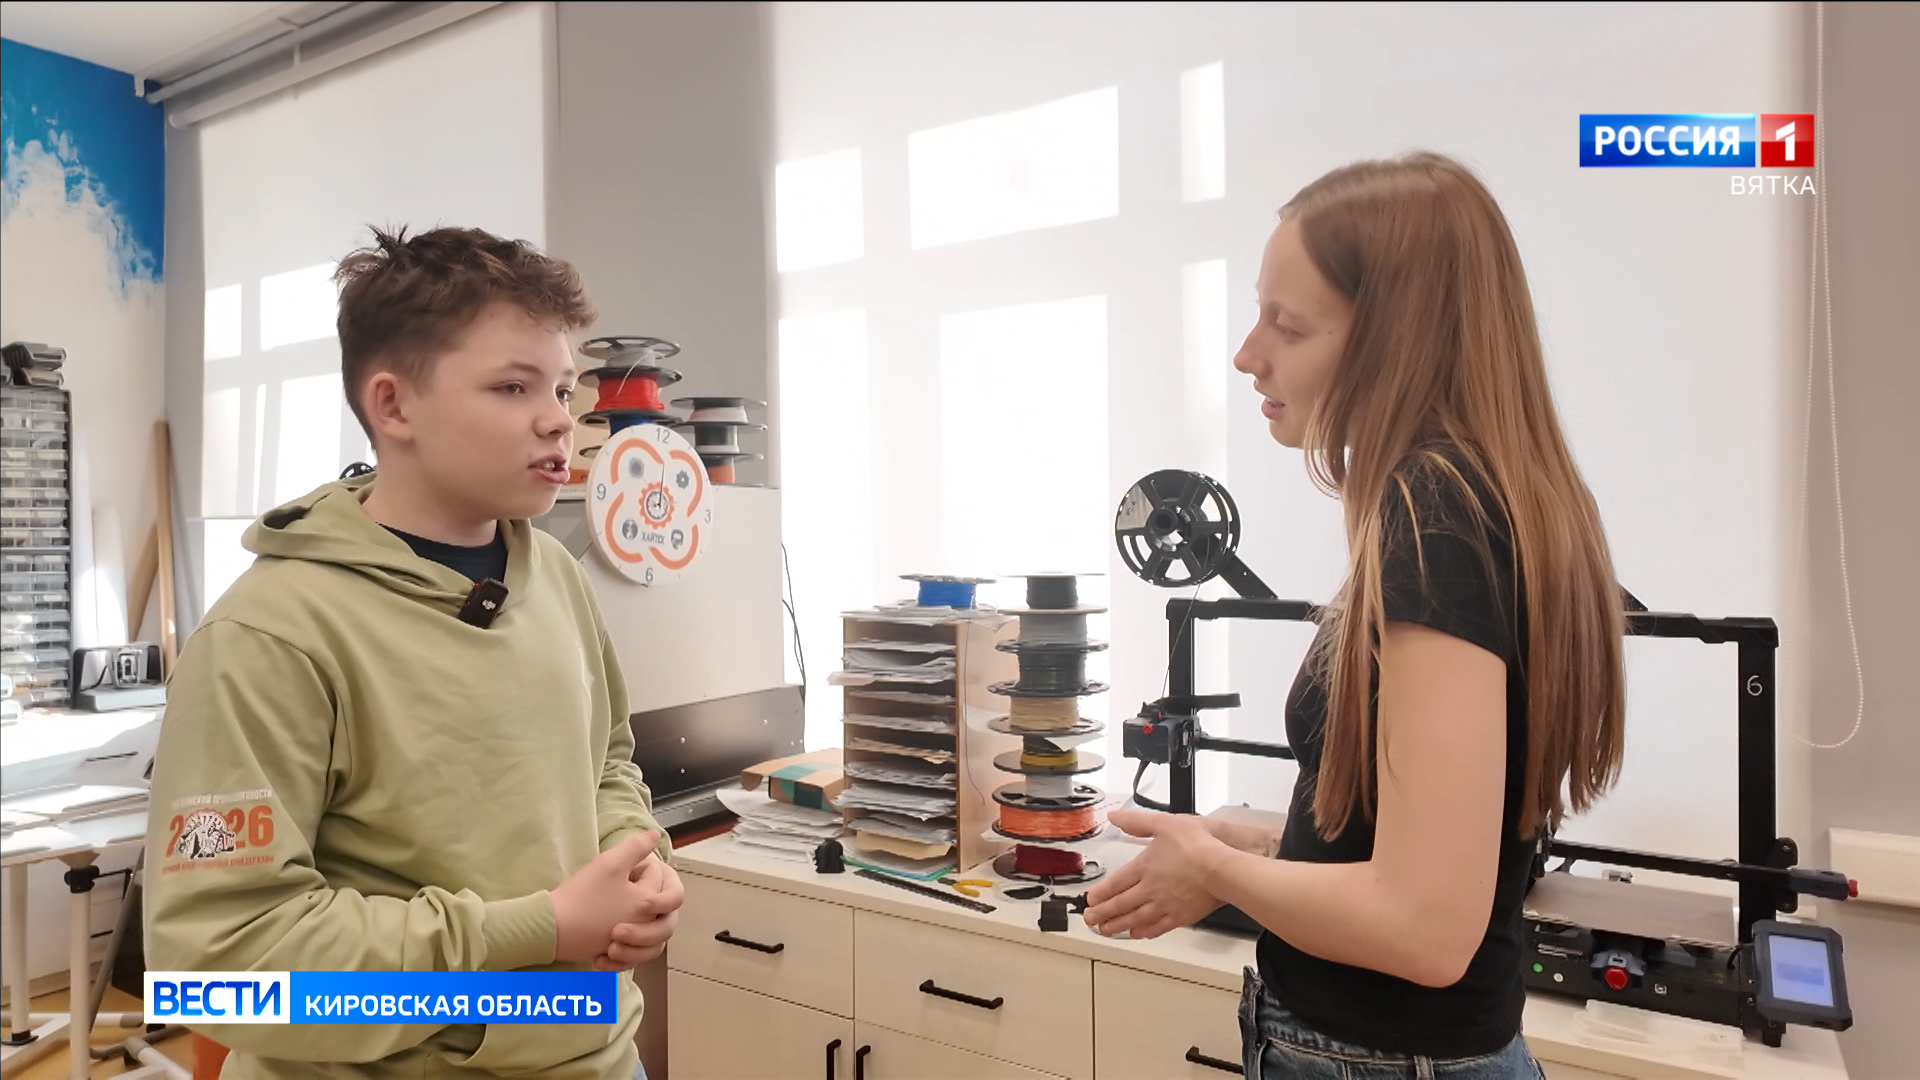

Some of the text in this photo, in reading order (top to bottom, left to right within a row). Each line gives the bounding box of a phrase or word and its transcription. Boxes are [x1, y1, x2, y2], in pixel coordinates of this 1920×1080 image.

[655, 427, 671, 444] 12
[596, 483, 607, 501] 9
[704, 509, 712, 524] 3
[645, 567, 654, 583] 6
[1746, 674, 1763, 697] 6
[165, 804, 275, 858] 226
